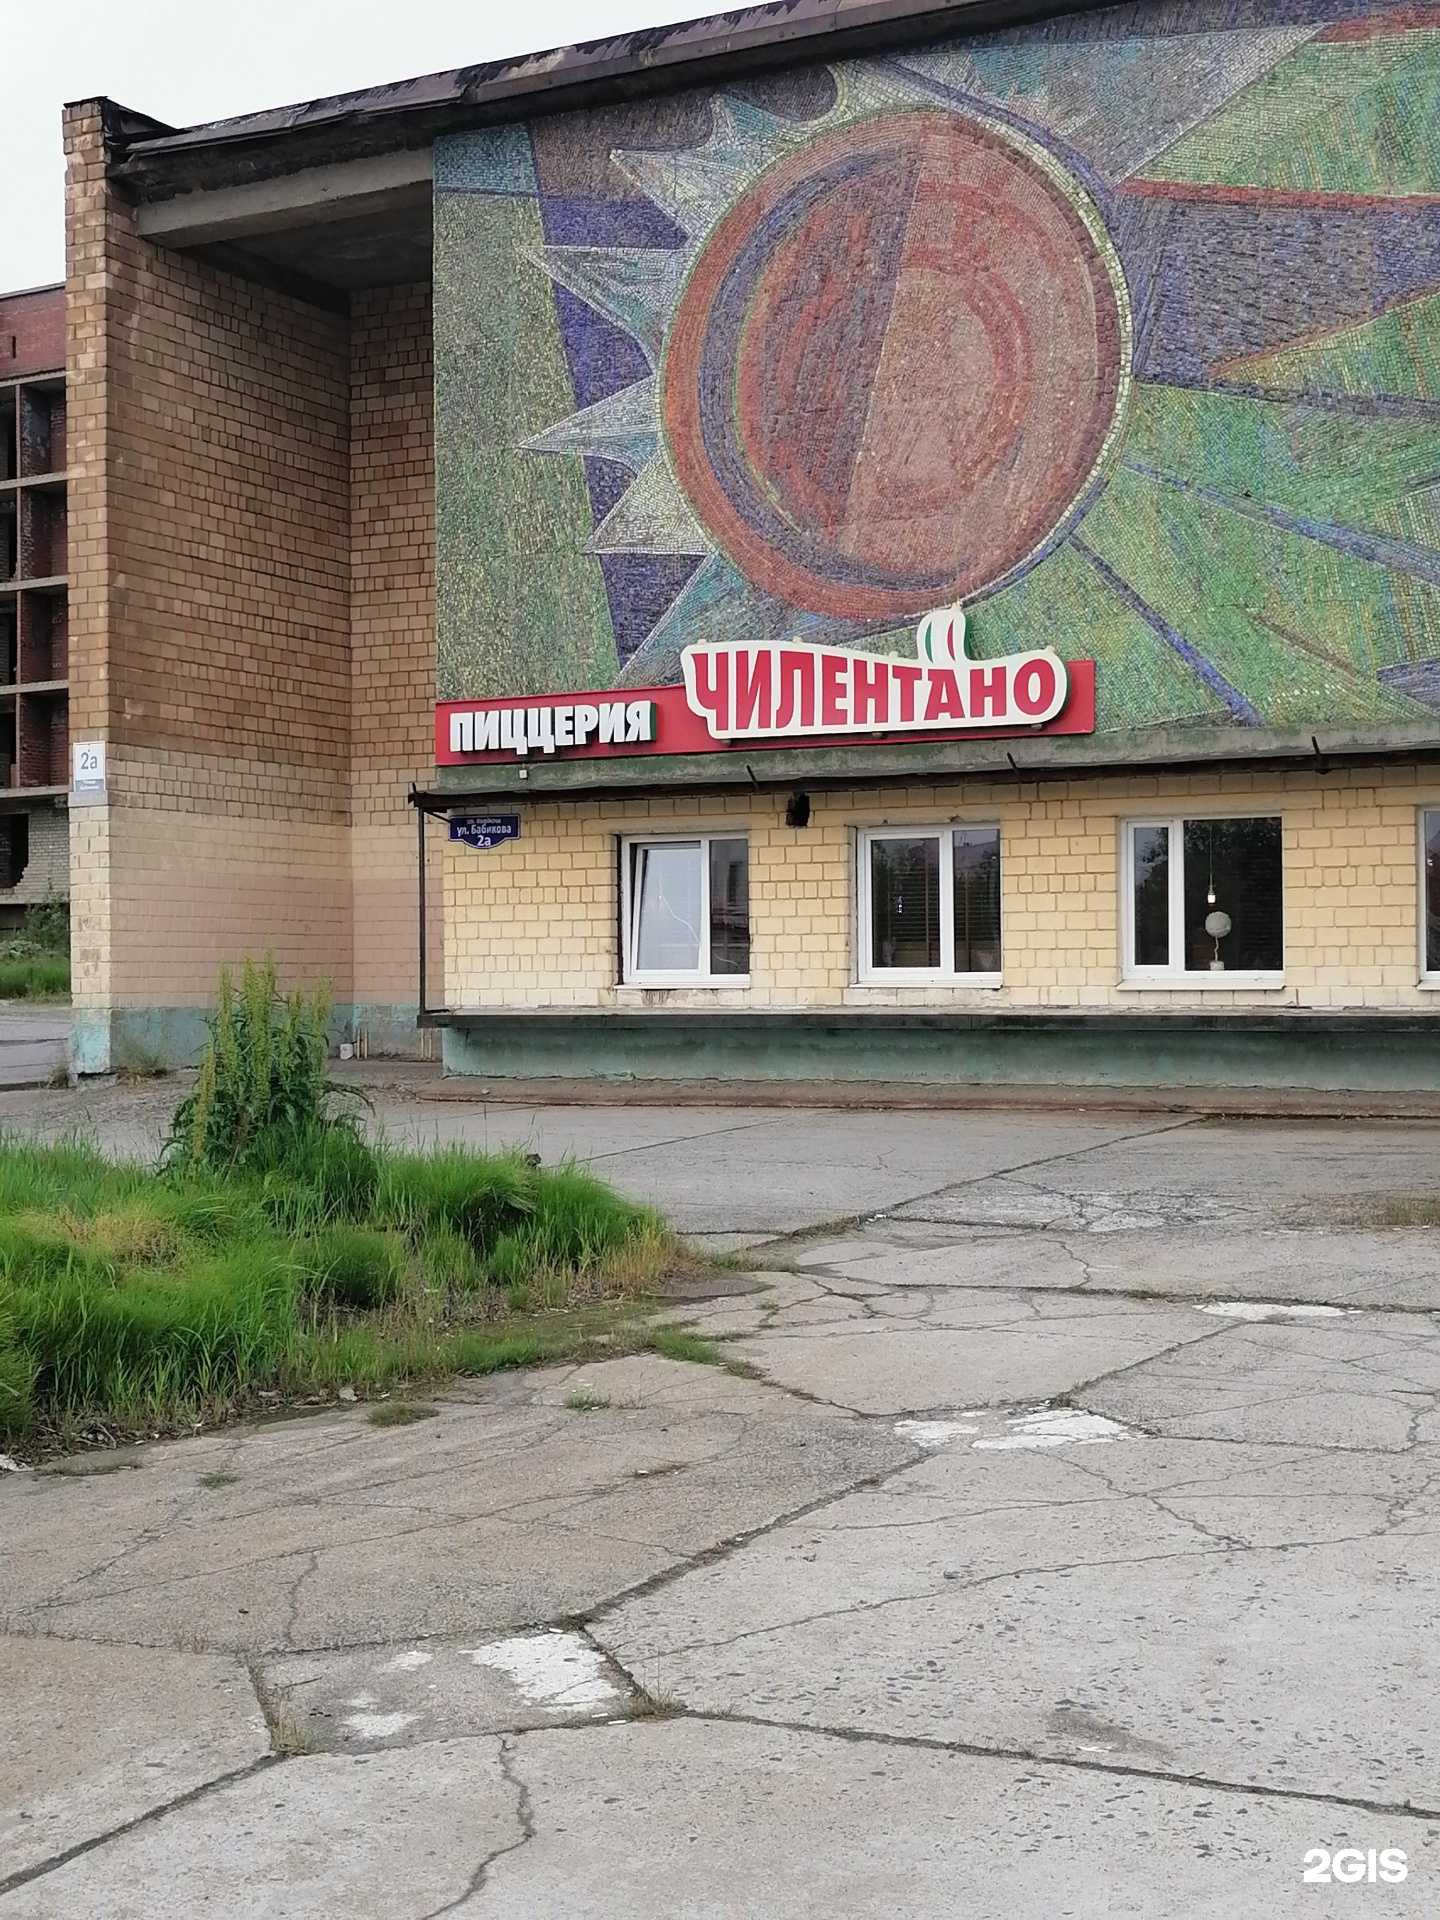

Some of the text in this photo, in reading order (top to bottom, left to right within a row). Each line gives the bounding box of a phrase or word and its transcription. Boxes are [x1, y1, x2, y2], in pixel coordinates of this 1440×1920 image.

[450, 649, 1056, 755] ПИЦЦЕРИЯ ЧИЛЕНТАНО
[80, 752, 98, 770] 2а
[456, 823, 512, 837] ул. Бабикова
[477, 834, 492, 846] 2а
